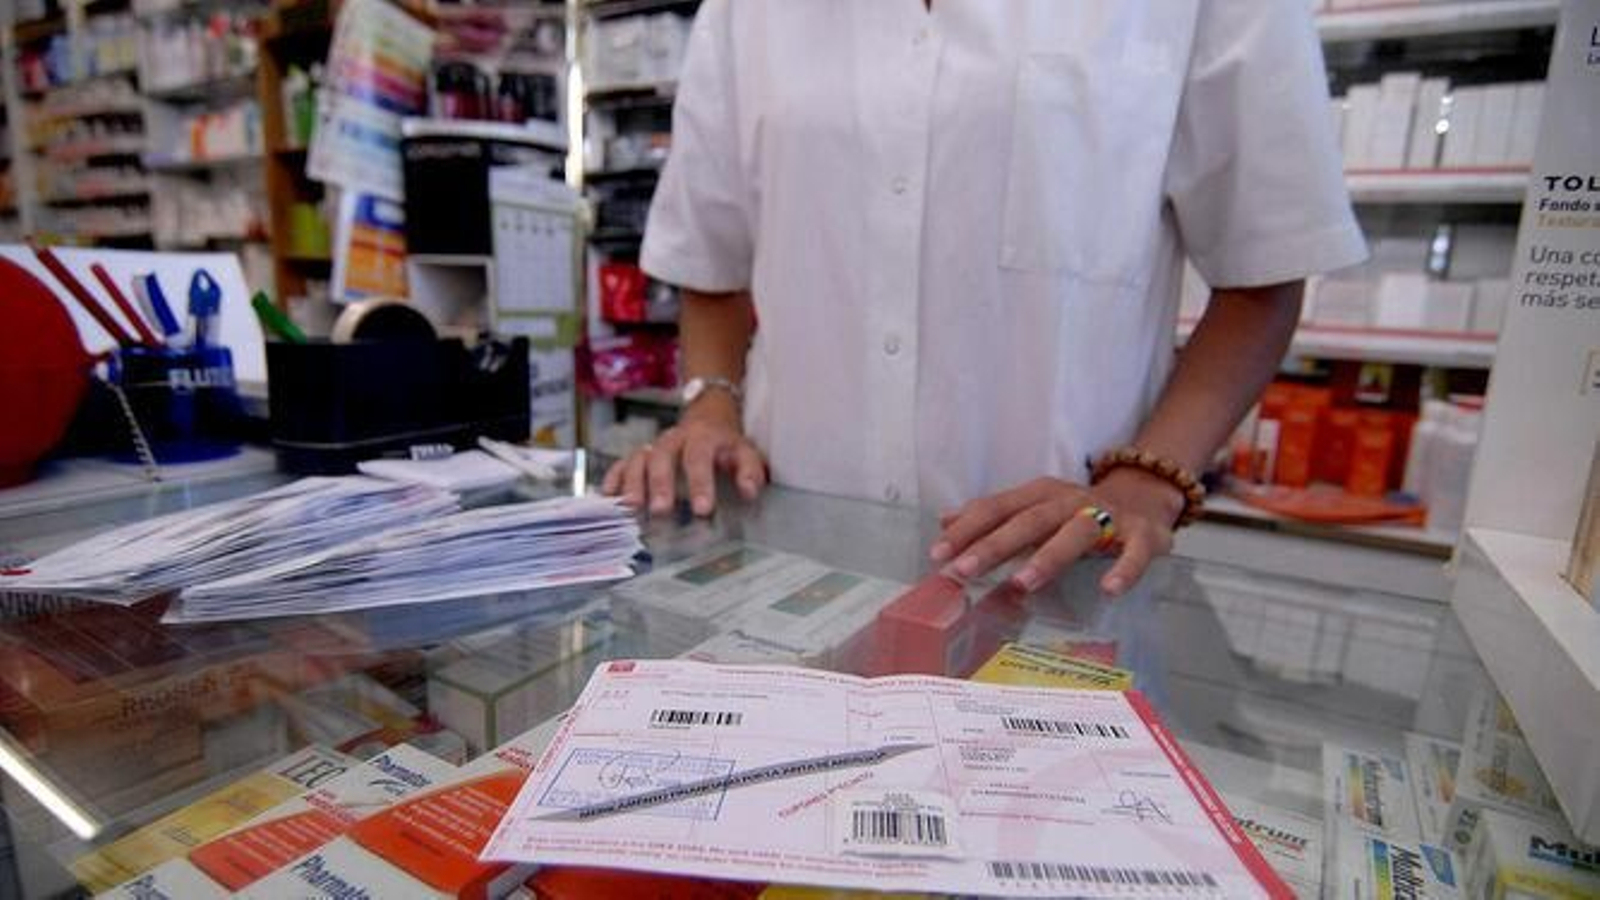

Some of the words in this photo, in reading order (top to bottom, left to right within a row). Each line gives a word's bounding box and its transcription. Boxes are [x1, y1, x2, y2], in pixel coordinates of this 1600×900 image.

[1544, 176, 1600, 192] TOL
[1539, 199, 1590, 211] Fondo
[1531, 246, 1573, 264] Una
[1525, 271, 1600, 290] respet
[1522, 289, 1568, 307] más
